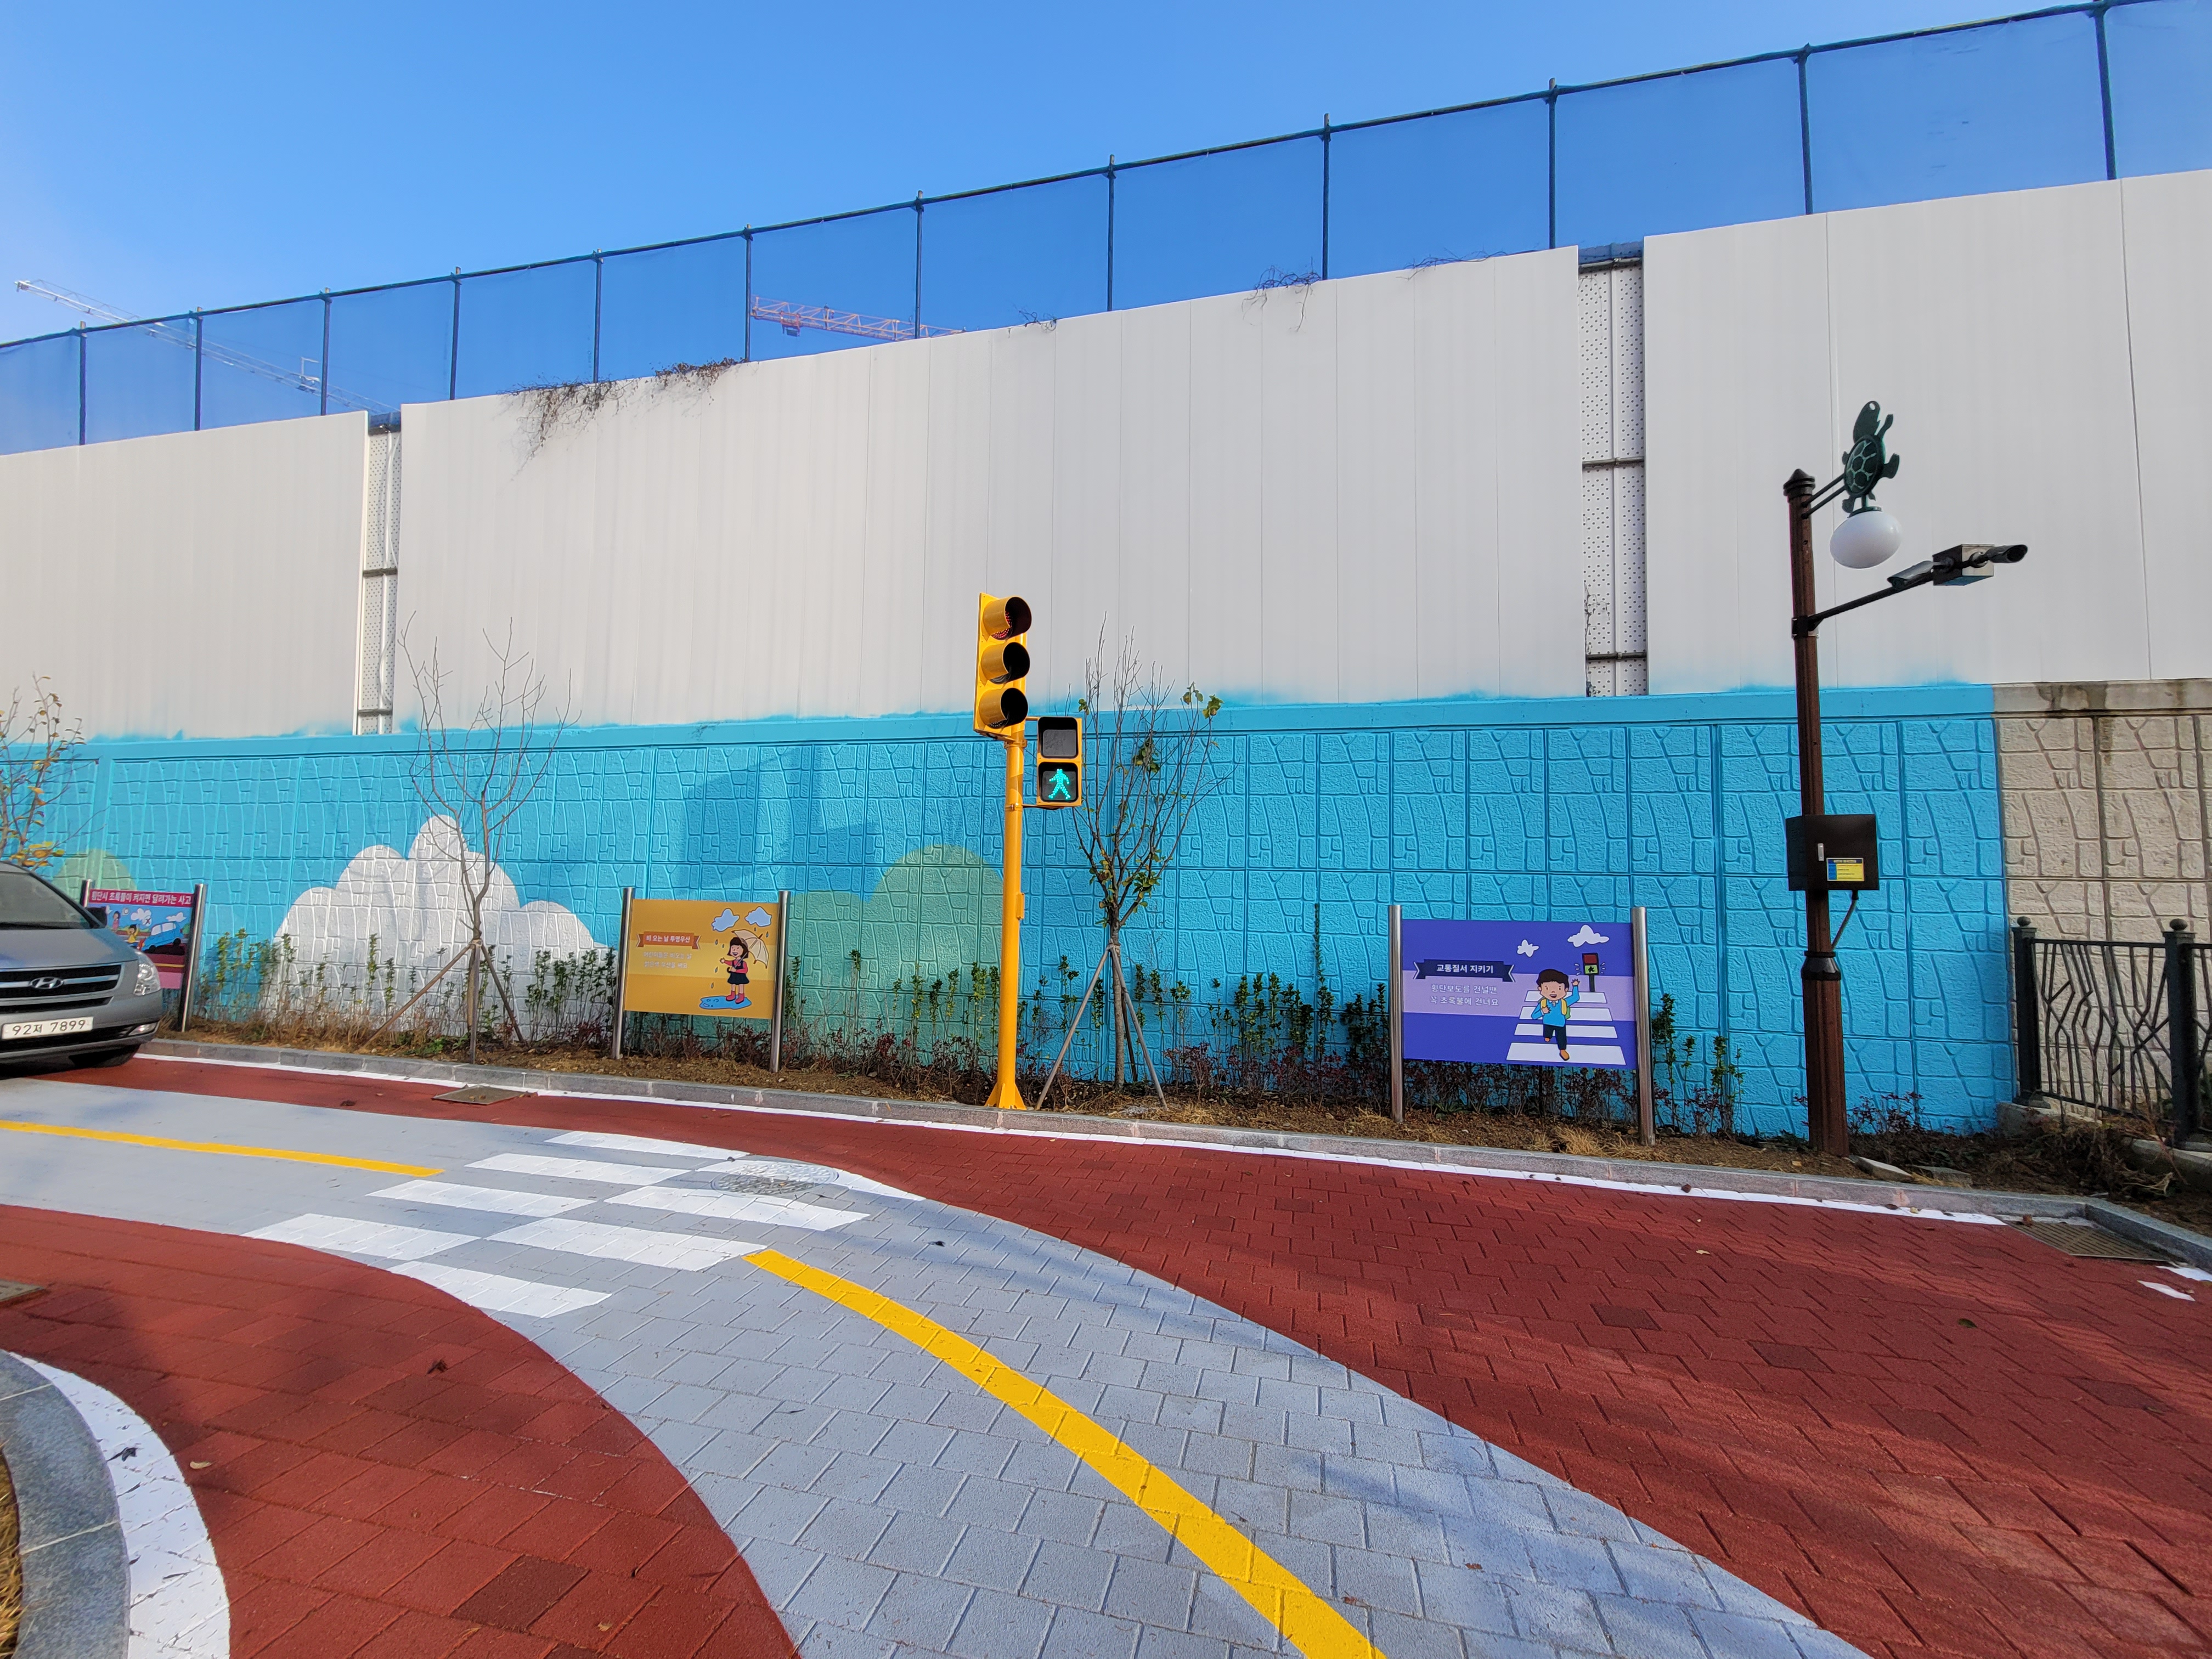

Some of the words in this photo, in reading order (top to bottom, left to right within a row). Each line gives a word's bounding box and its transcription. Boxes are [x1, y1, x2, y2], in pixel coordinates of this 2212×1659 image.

[178, 895, 191, 905] 사고
[1436, 964, 1468, 973] 교통질서
[1470, 964, 1493, 974] 지키기
[1431, 984, 1470, 993] 횡단보도를
[1473, 985, 1497, 994] 건널땐
[1430, 996, 1437, 1004] 꼭
[1440, 996, 1472, 1006] 초록불에
[1475, 997, 1499, 1006] 건너요
[12, 1024, 43, 1036] 92저
[50, 1019, 86, 1033] 7899
